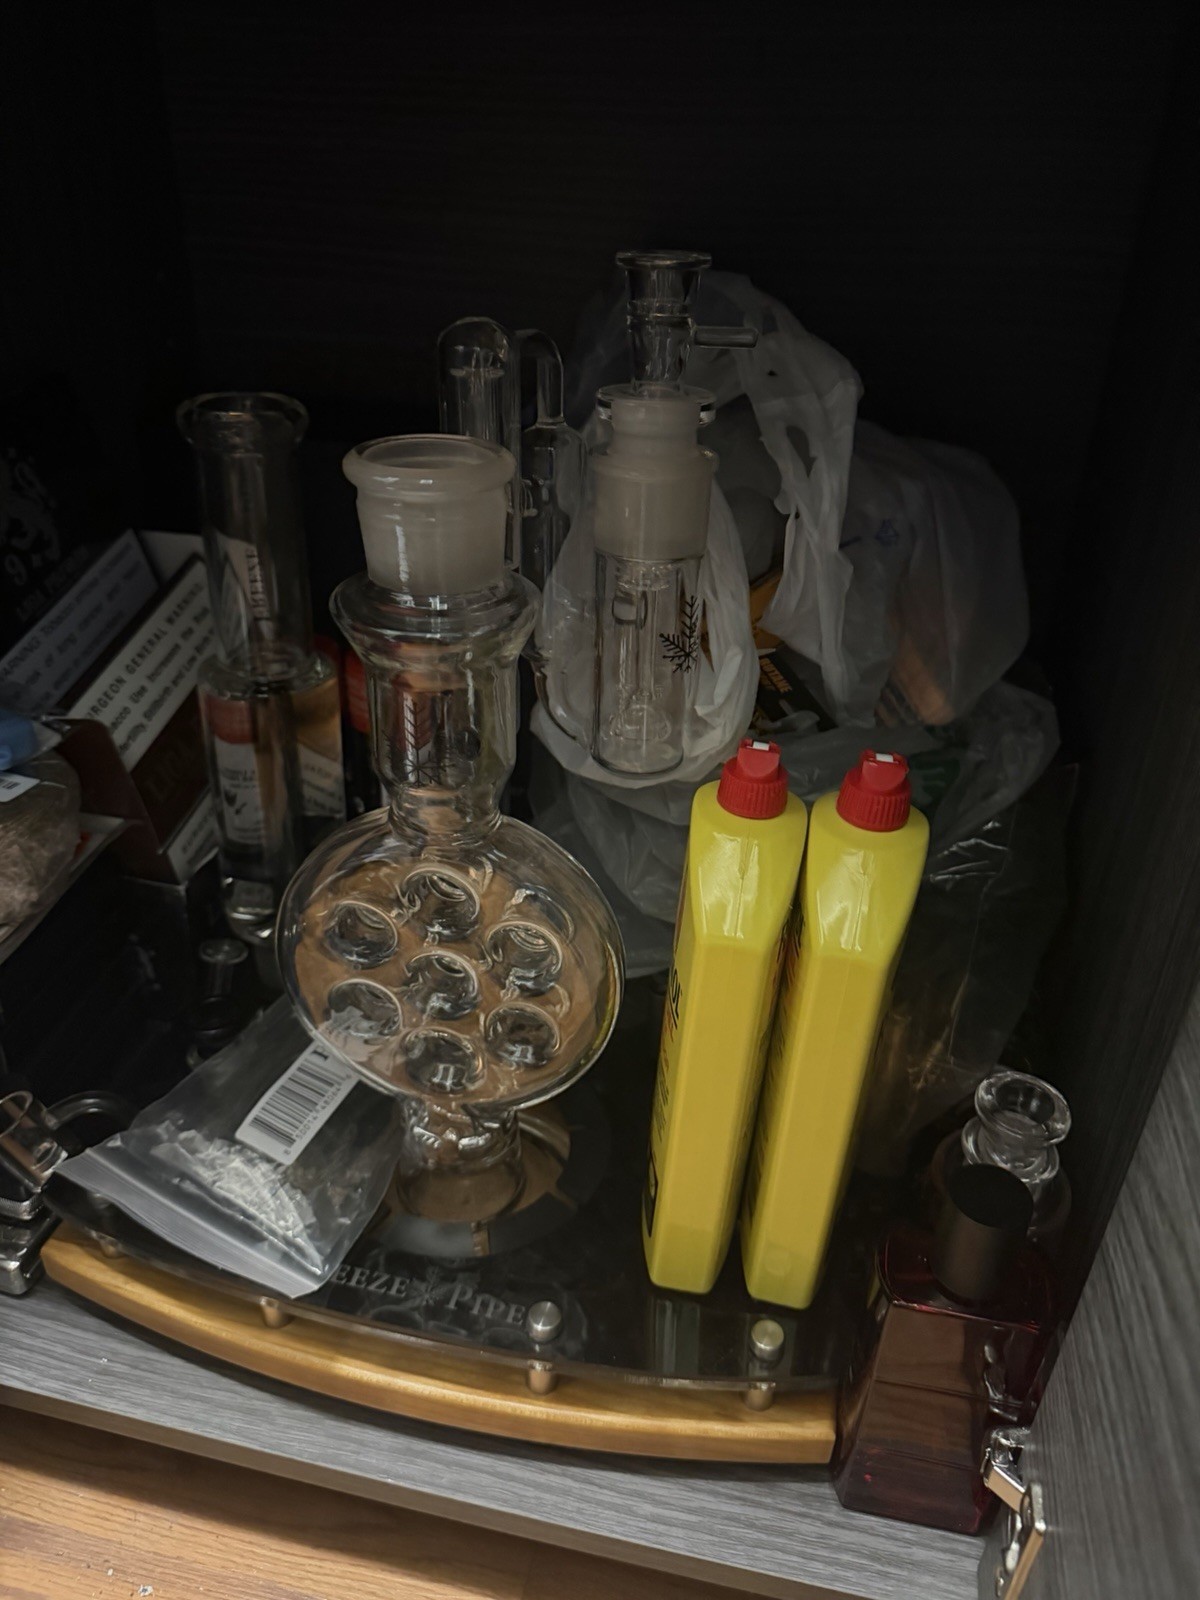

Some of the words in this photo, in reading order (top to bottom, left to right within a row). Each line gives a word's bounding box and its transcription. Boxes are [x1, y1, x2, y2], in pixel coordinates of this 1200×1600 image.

[86, 674, 126, 719] RGEON
[124, 625, 167, 675] GENERAL
[330, 1263, 410, 1298] EEZE
[446, 1284, 527, 1326] PIPE
